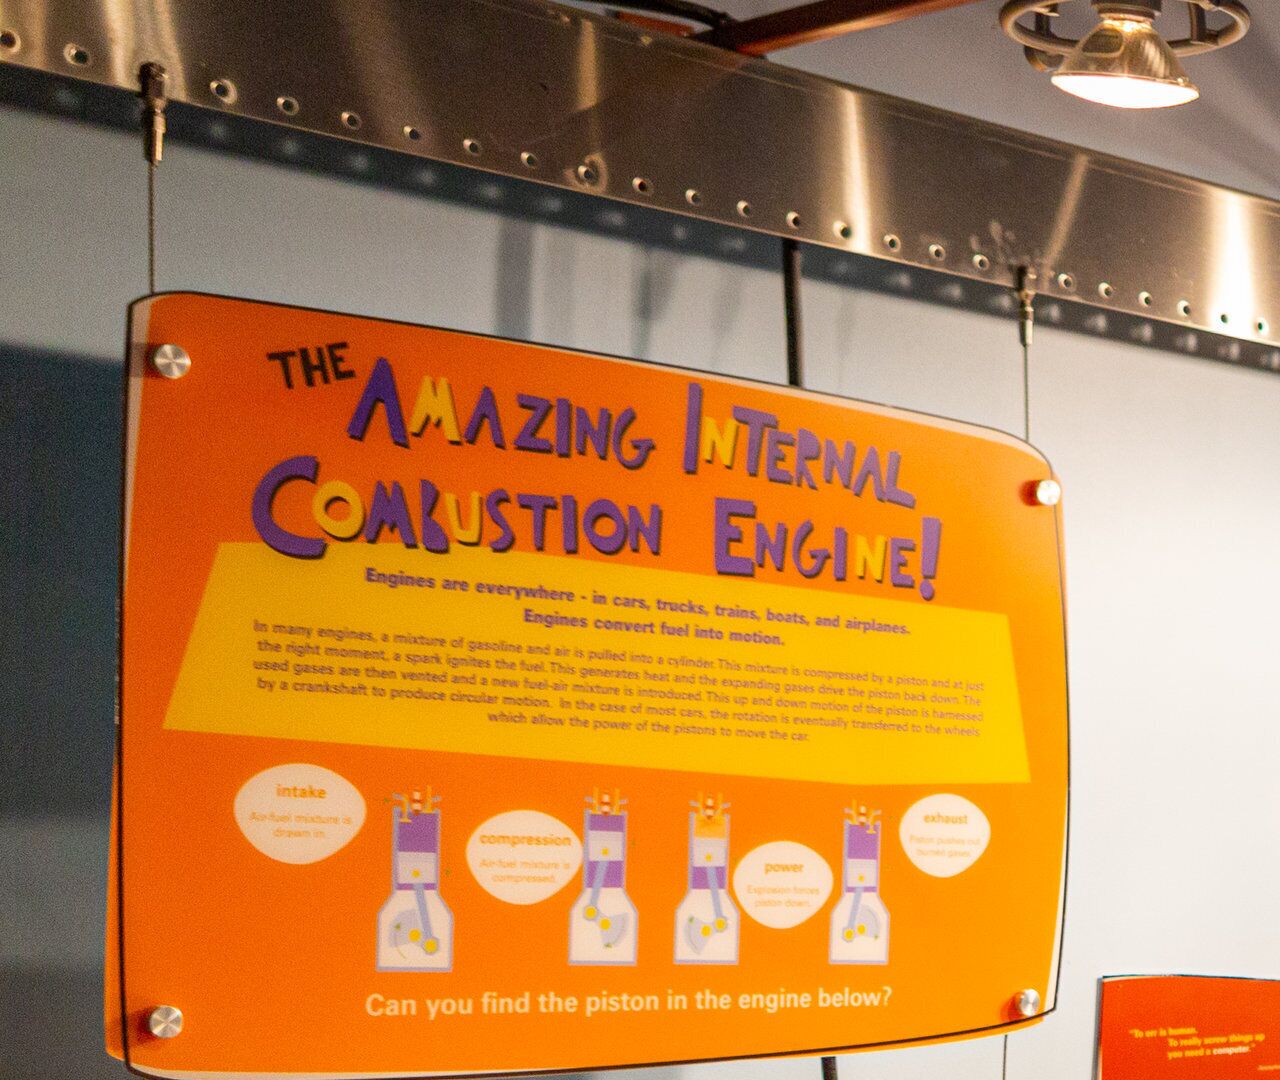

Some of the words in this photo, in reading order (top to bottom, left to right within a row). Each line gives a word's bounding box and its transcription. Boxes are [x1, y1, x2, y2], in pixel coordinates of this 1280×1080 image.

[267, 342, 356, 389] THE
[347, 357, 656, 469] AMAZING
[683, 382, 916, 509] INTERNAL
[251, 455, 661, 560] COMBUSTION
[714, 496, 942, 601] ENGINE!
[365, 569, 436, 589] Engines
[442, 579, 469, 592] are
[475, 582, 575, 602] everywhere
[592, 590, 607, 605] in
[656, 596, 709, 617] trucks,
[714, 602, 761, 622] trains,
[766, 607, 810, 627] boats,
[815, 613, 840, 628] and
[845, 615, 911, 635] airplanes.
[523, 609, 588, 628] Engines
[593, 618, 655, 634] convert
[660, 620, 690, 637] fuel
[694, 623, 724, 640] into
[254, 621, 268, 633] In
[272, 625, 312, 639] many
[317, 628, 377, 643] engines,
[381, 634, 389, 643] a
[393, 633, 446, 647] mixture
[450, 637, 464, 649] of
[467, 640, 522, 654] gasoline
[527, 644, 550, 656] and
[554, 645, 570, 658] air
[574, 647, 584, 659] is
[589, 649, 626, 663] pulled
[630, 651, 653, 664] into
[657, 656, 664, 665] a
[717, 659, 741, 671] This
[745, 661, 788, 675] mixture
[791, 664, 800, 676] is
[803, 668, 868, 682] compressed
[871, 671, 884, 686] by
[887, 675, 894, 684] a
[896, 673, 928, 688] piston
[931, 677, 950, 688] and
[953, 678, 963, 689] at
[965, 678, 984, 693] just
[257, 639, 282, 651] the
[285, 641, 320, 657] right
[393, 653, 402, 661] a
[405, 653, 442, 666] spark
[447, 654, 491, 669] ignites
[495, 658, 516, 671] the
[549, 663, 576, 675] This
[580, 667, 640, 680] generates
[643, 669, 670, 683] heat
[674, 673, 696, 685] and
[699, 674, 718, 686] the
[721, 678, 781, 694] expanding
[784, 683, 815, 695] gases
[818, 683, 845, 696] drive
[848, 685, 865, 697] the
[868, 687, 900, 701] piston
[903, 689, 927, 702] back
[963, 694, 981, 706] The
[253, 660, 289, 672] used
[293, 664, 334, 676] gases
[339, 667, 361, 677] are
[365, 667, 397, 679] then
[401, 671, 447, 683] vented
[450, 673, 476, 685] and
[480, 677, 488, 686] a
[491, 678, 519, 688] new
[524, 677, 568, 692] fuel-air
[572, 681, 620, 696] mixture
[623, 685, 633, 697] is
[706, 691, 730, 703] This
[734, 696, 748, 708] up
[752, 695, 772, 707] and
[776, 696, 807, 709] down
[810, 699, 849, 712] motion
[852, 701, 864, 713] of
[866, 703, 883, 715] the
[885, 704, 918, 718] piston
[921, 706, 929, 718] is
[932, 707, 983, 722] harnessed
[276, 784, 327, 799] intake
[480, 834, 572, 848] compression
[923, 812, 968, 824] exhaust
[764, 863, 804, 875] power
[365, 993, 416, 1016] Can
[426, 999, 473, 1020] you
[481, 991, 530, 1014] find
[538, 991, 578, 1012] the
[585, 990, 659, 1017] piston
[666, 989, 688, 1010] in
[695, 988, 731, 1010] the
[738, 988, 812, 1013] engine
[818, 986, 892, 1008] below?
